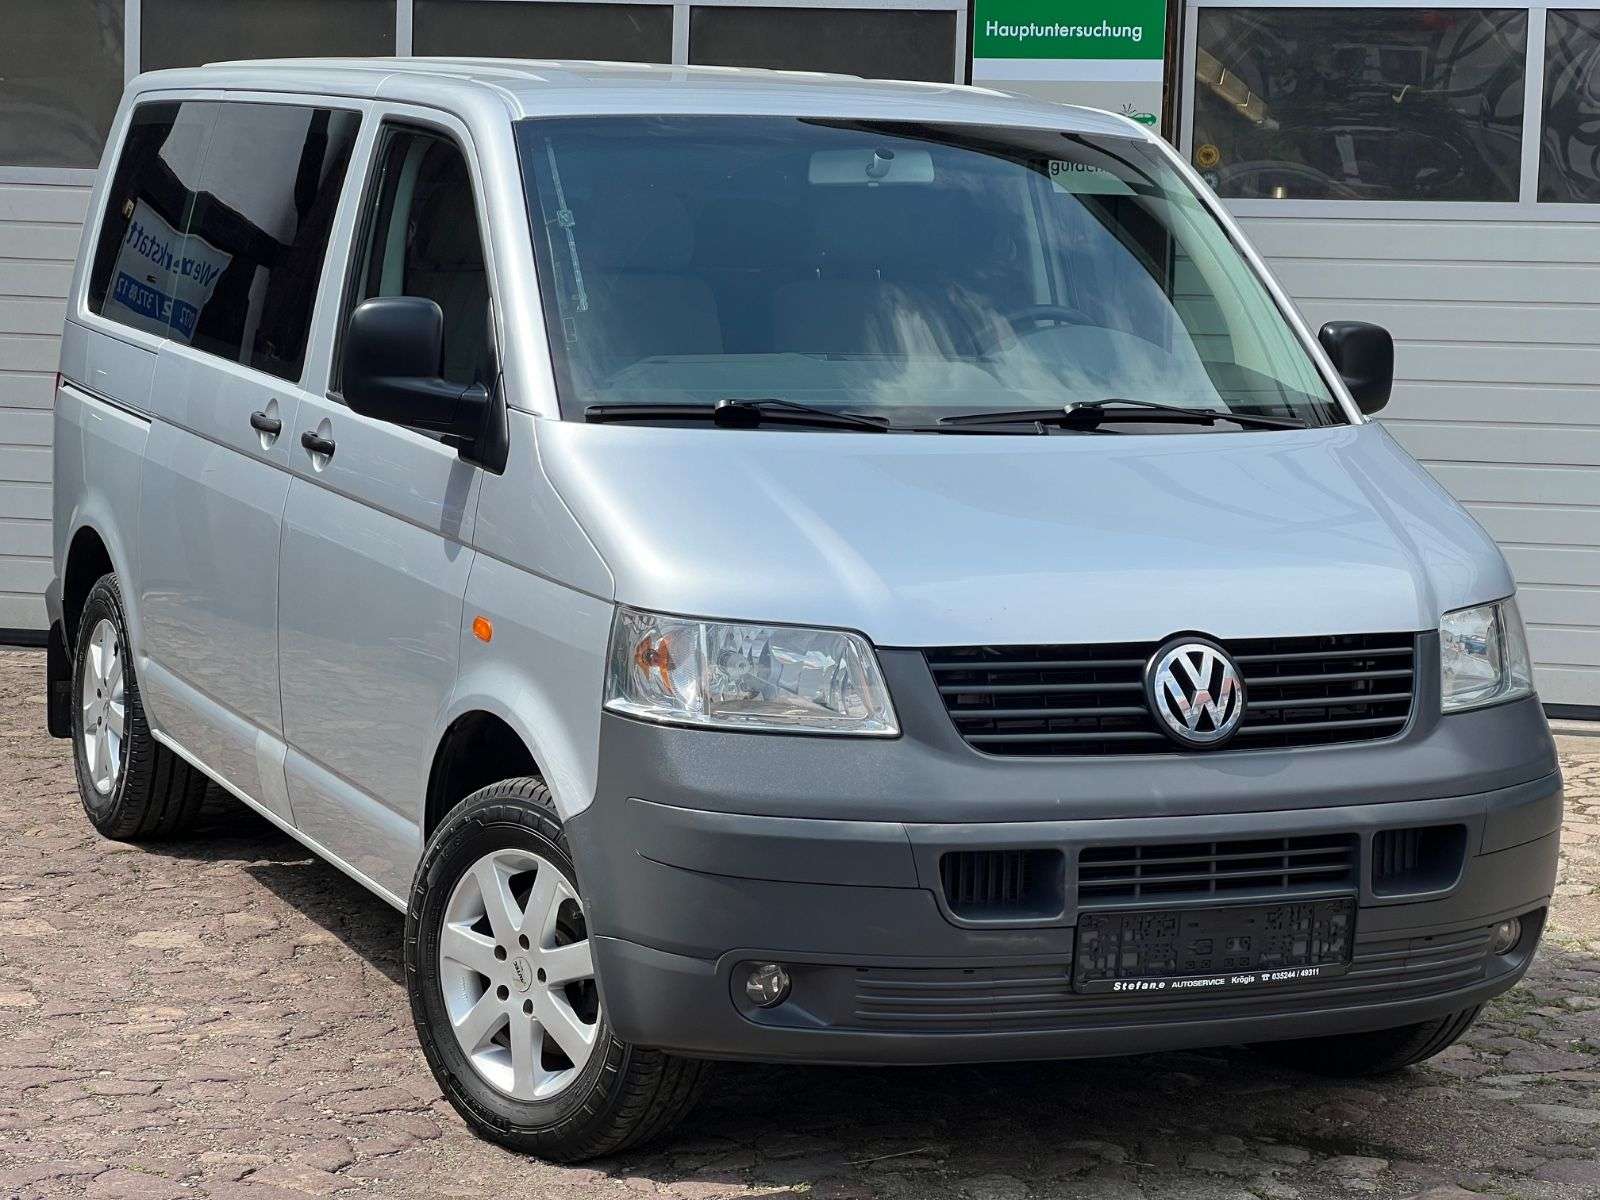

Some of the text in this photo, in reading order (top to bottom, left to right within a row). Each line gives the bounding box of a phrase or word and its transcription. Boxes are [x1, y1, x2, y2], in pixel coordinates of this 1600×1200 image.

[986, 20, 1143, 42] Hauptuntersuchung
[1154, 643, 1243, 742] VW
[1171, 978, 1226, 988] AUTOSERVICE
[1231, 975, 1255, 985] Krögis
